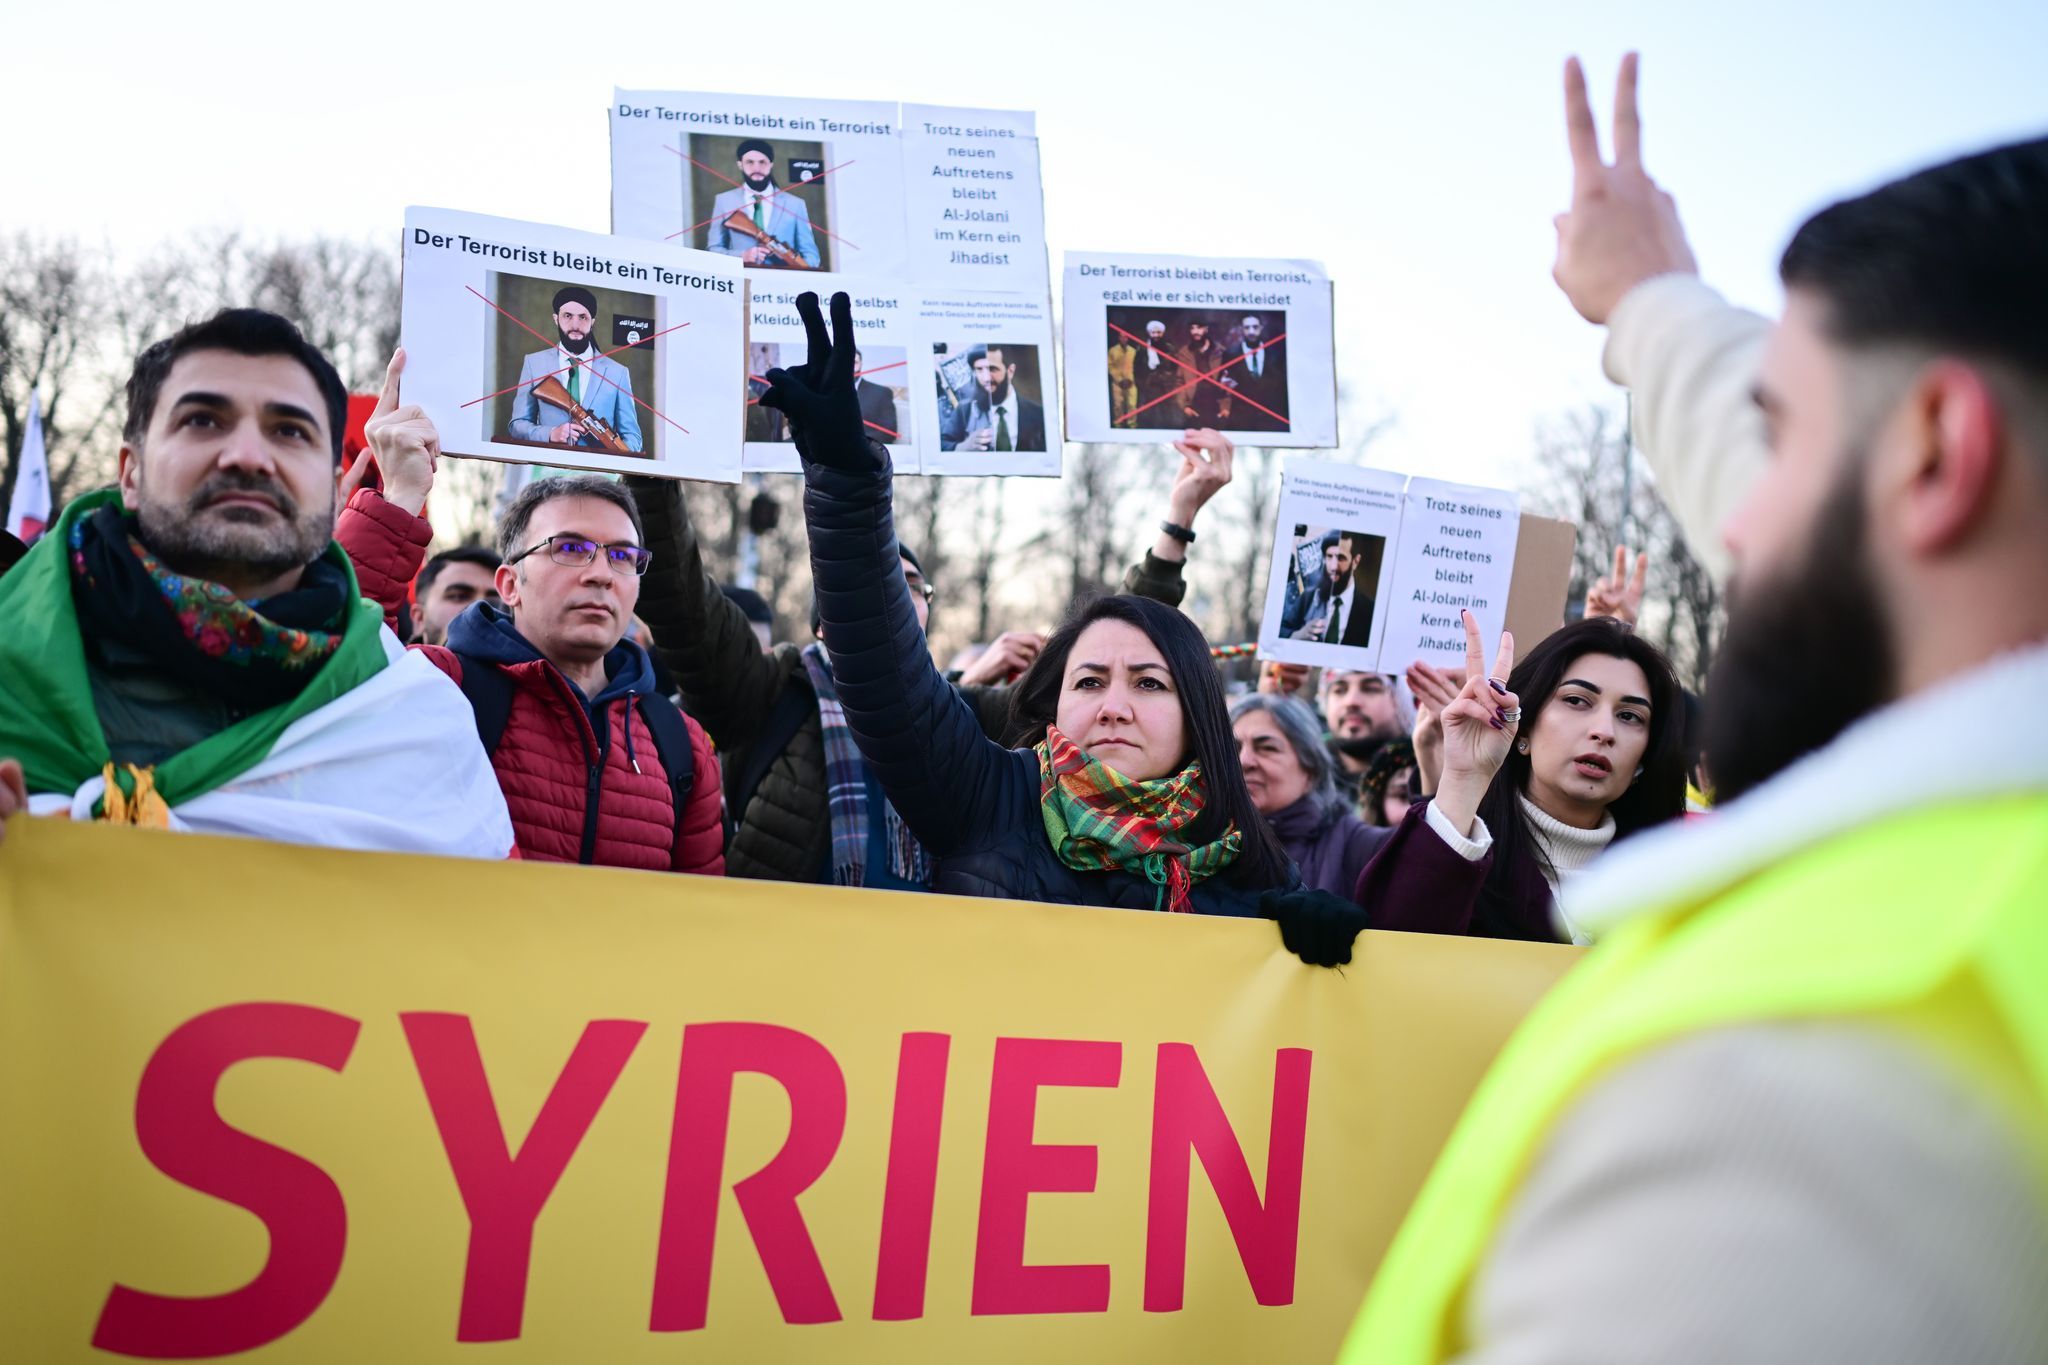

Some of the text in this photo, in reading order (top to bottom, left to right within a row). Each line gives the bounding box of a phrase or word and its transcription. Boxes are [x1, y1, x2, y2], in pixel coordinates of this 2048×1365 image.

[619, 104, 891, 135] Der Terrorist bleibt ein Terrorist
[924, 123, 1015, 138] Trotz seines
[948, 147, 995, 159] neuen
[932, 165, 1014, 180] Auftretens
[952, 187, 997, 200] bleibt
[943, 208, 1009, 223] Al-Jolani
[934, 228, 1021, 243] im Kern ein
[414, 228, 735, 294] Der Terrorist bleibt ein Terrorist
[950, 250, 1010, 265] Jihadist
[1080, 264, 1312, 285] Der Terrorist bleibt ein Terrorist,
[777, 293, 797, 305] sic
[855, 297, 899, 309] selbst
[1103, 288, 1291, 306] egal wie er sich verkleidet
[754, 313, 804, 326] Kleidu
[1425, 496, 1502, 519] Trotz seines
[1440, 525, 1482, 540] neuen
[1422, 543, 1492, 564] Auftretens
[1435, 568, 1474, 584] bleibt
[1412, 589, 1488, 608] Al-Jolani im
[1421, 613, 1451, 628] Kern
[90, 1001, 1313, 1360] SYRIEN
